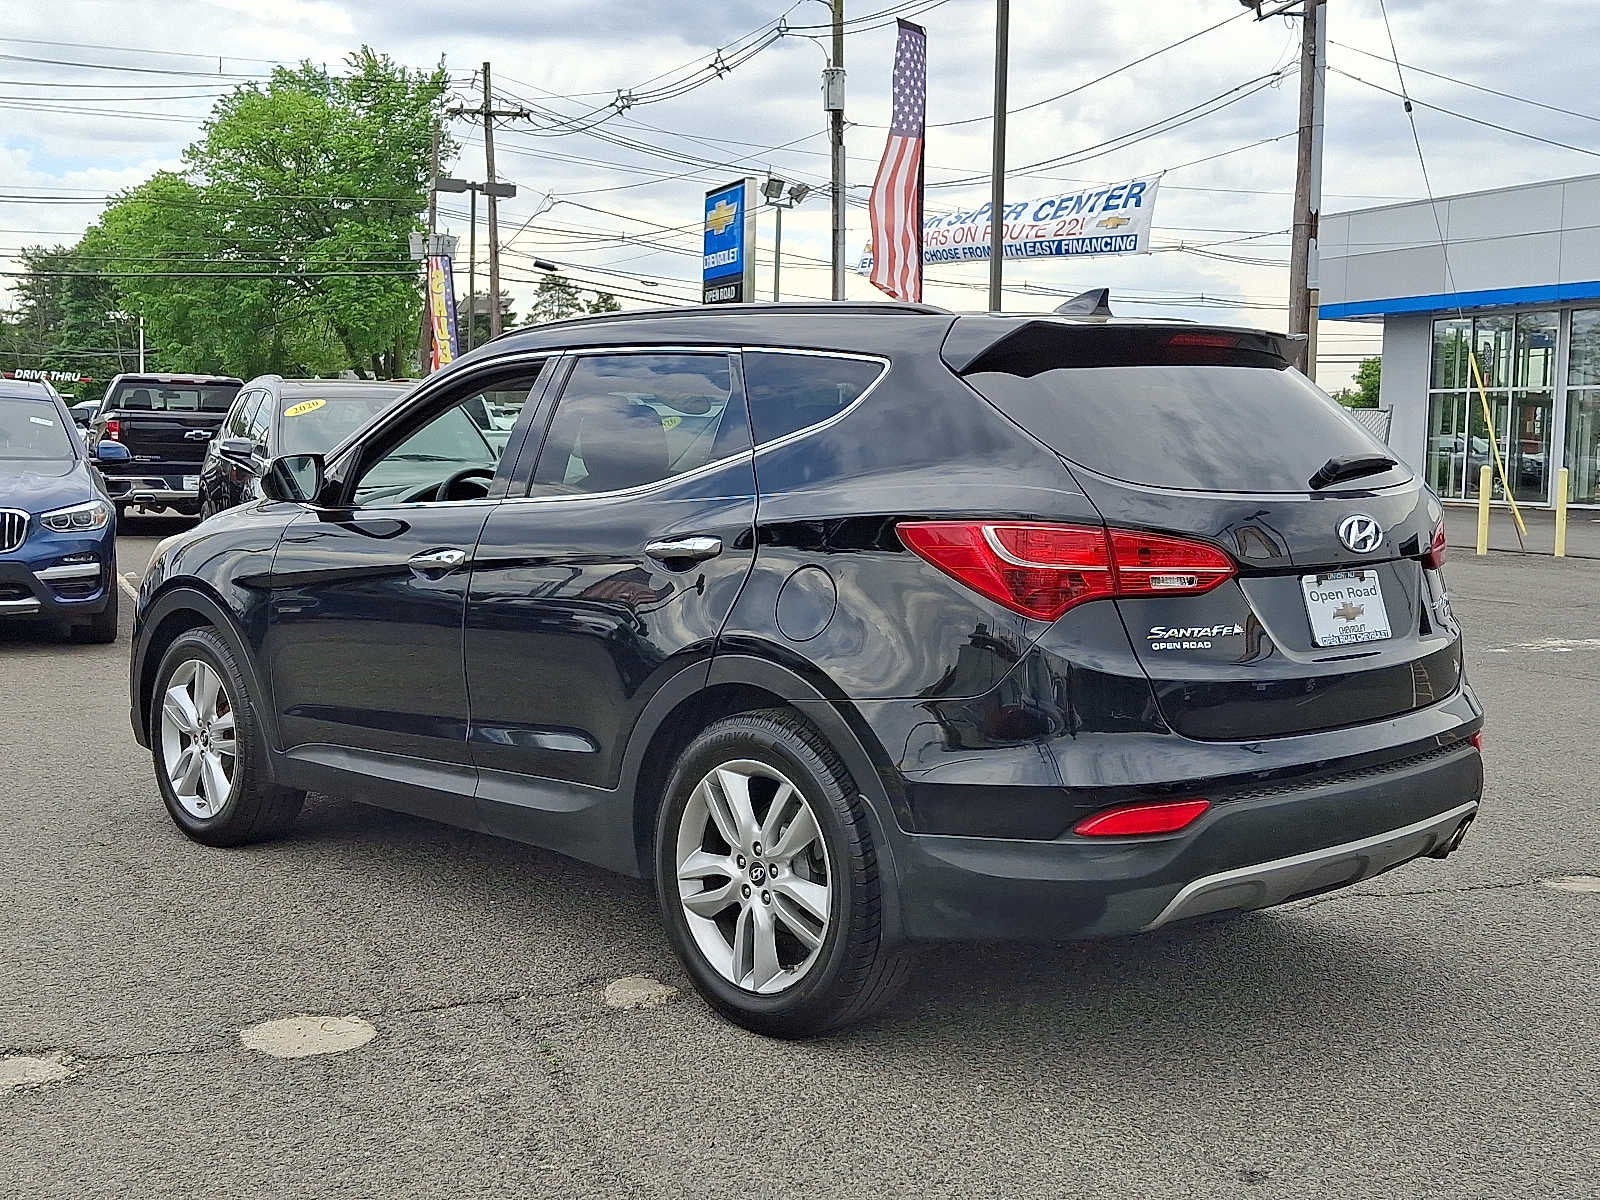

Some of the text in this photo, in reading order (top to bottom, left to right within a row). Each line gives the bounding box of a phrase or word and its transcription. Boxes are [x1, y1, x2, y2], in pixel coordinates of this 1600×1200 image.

[1032, 182, 1146, 221] CENTER
[952, 225, 979, 245] ON
[1053, 217, 1086, 237] 22!
[924, 247, 961, 262] CHOOSE
[962, 245, 992, 259] FROM
[1003, 243, 1023, 257] ITH
[1026, 240, 1060, 256] EASY
[1060, 235, 1138, 255] FINANCING
[705, 286, 735, 303] OPEN ROAD
[14, 369, 81, 382] DRIVE THRU
[1309, 585, 1377, 604] Open Road
[1151, 641, 1212, 651] OPEN ROAD
